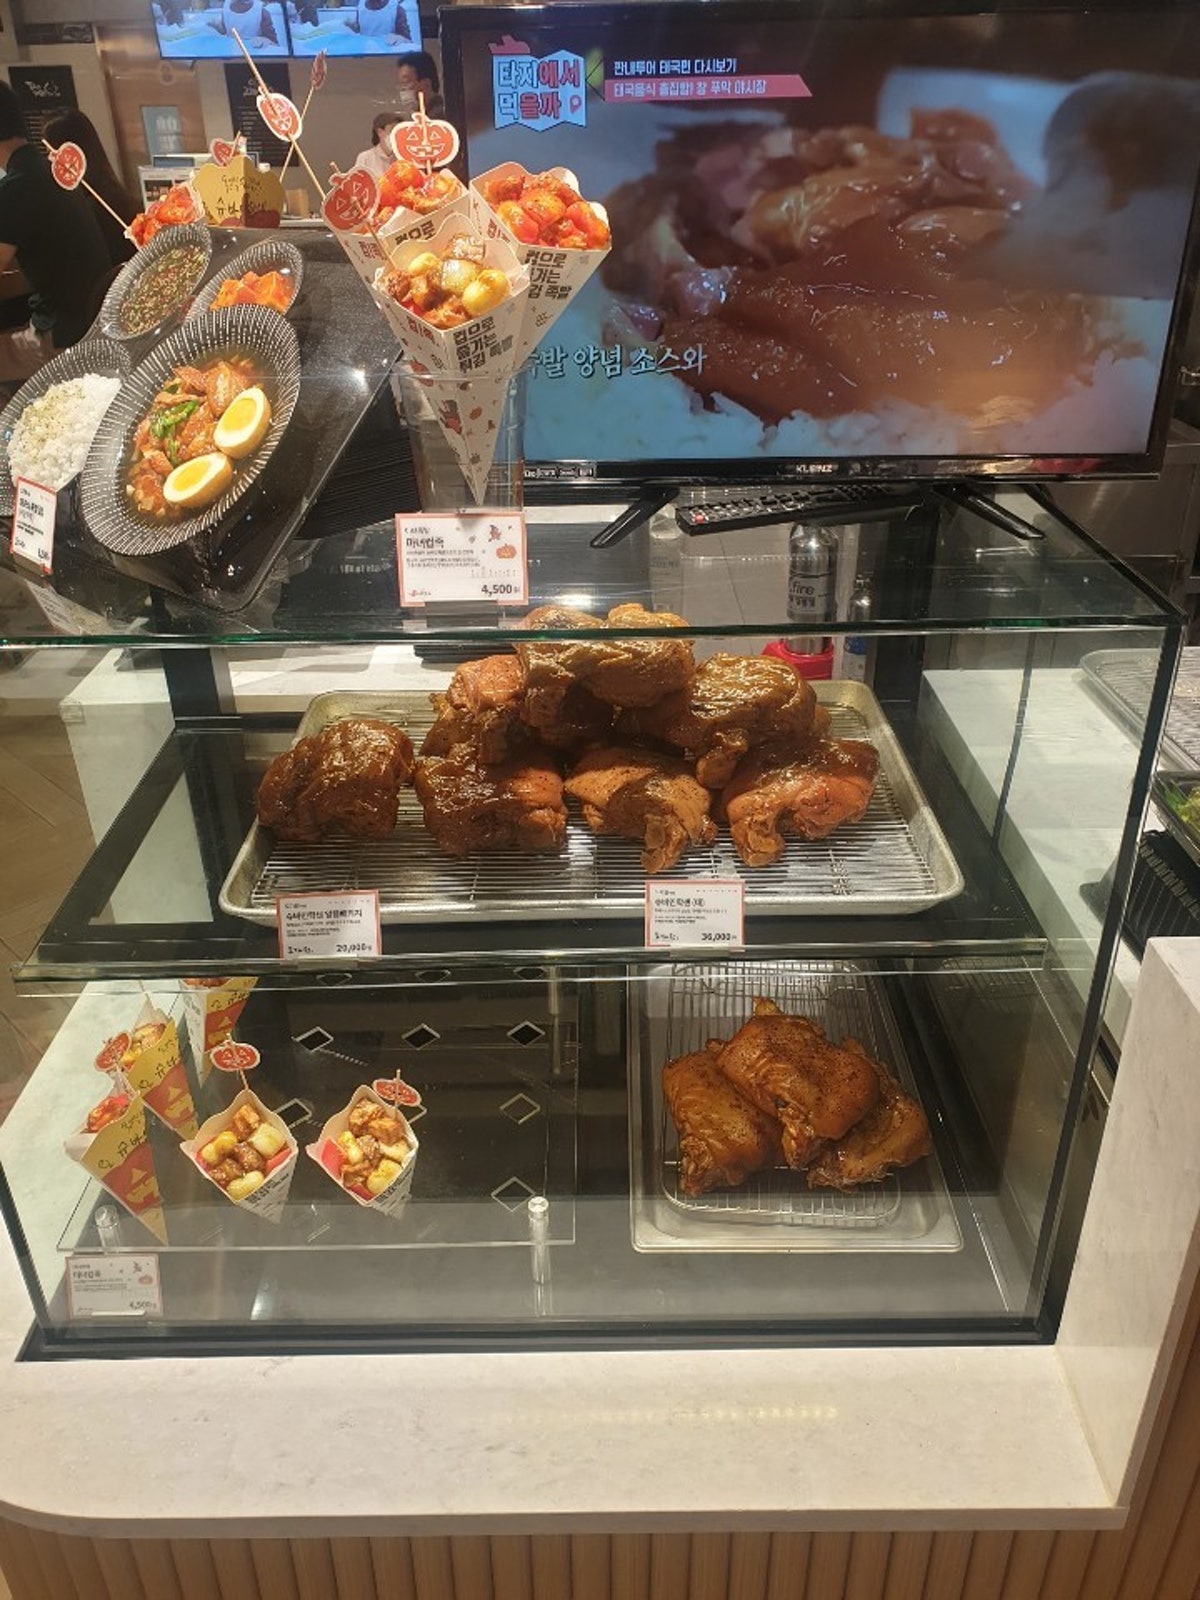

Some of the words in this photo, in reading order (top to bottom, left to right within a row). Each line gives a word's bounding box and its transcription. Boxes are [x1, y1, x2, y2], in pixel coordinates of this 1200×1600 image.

[498, 59, 581, 88] 타지에서
[694, 58, 738, 74] 다시보기
[734, 79, 768, 95] 야시장
[530, 267, 560, 284] 기는
[453, 316, 496, 346] 컵으로
[573, 343, 623, 379] 양념
[630, 343, 707, 376] 소스와
